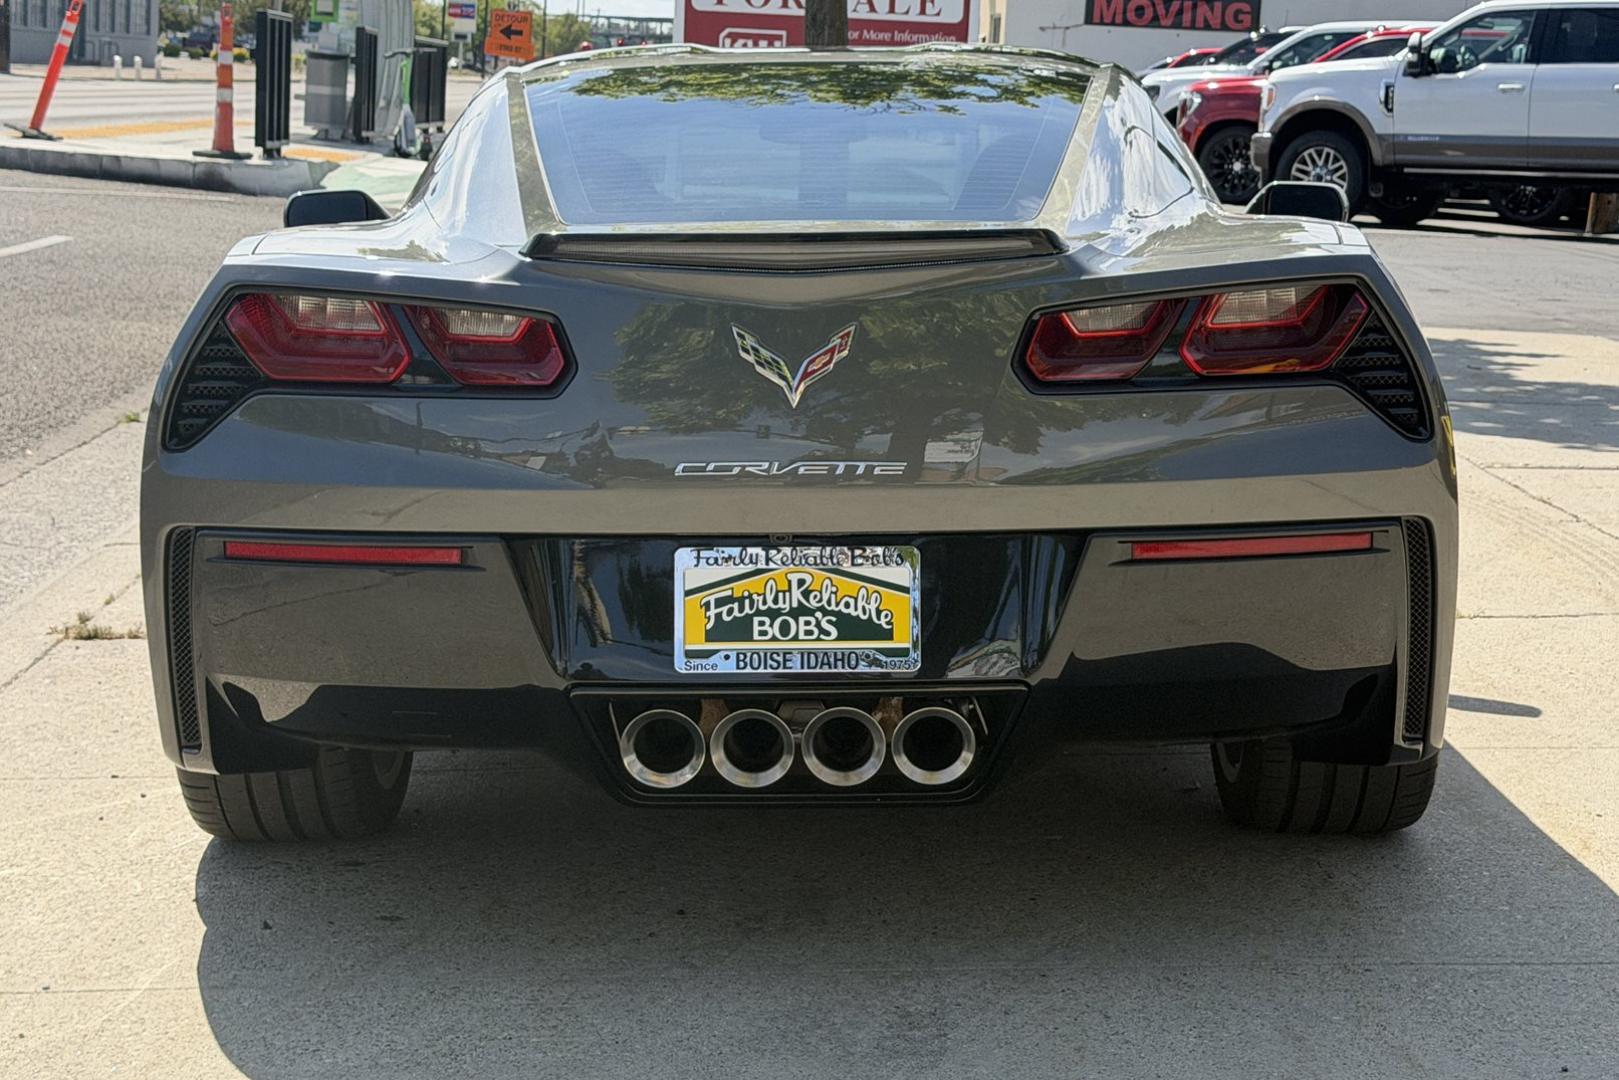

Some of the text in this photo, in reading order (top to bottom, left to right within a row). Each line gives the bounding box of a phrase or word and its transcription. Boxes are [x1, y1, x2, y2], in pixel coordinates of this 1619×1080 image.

[852, 0, 942, 16] ALE
[1092, 0, 1252, 30] MOVING
[494, 13, 529, 24] DETOUR
[847, 29, 956, 44] or More Information
[674, 461, 908, 476] CORVETTE
[690, 546, 904, 567] Fairly Reliable Bob's
[700, 571, 893, 630] Fairly Reliable
[752, 612, 839, 641] BOB'S
[684, 651, 912, 671] Since BOISE IDAHO 1975
